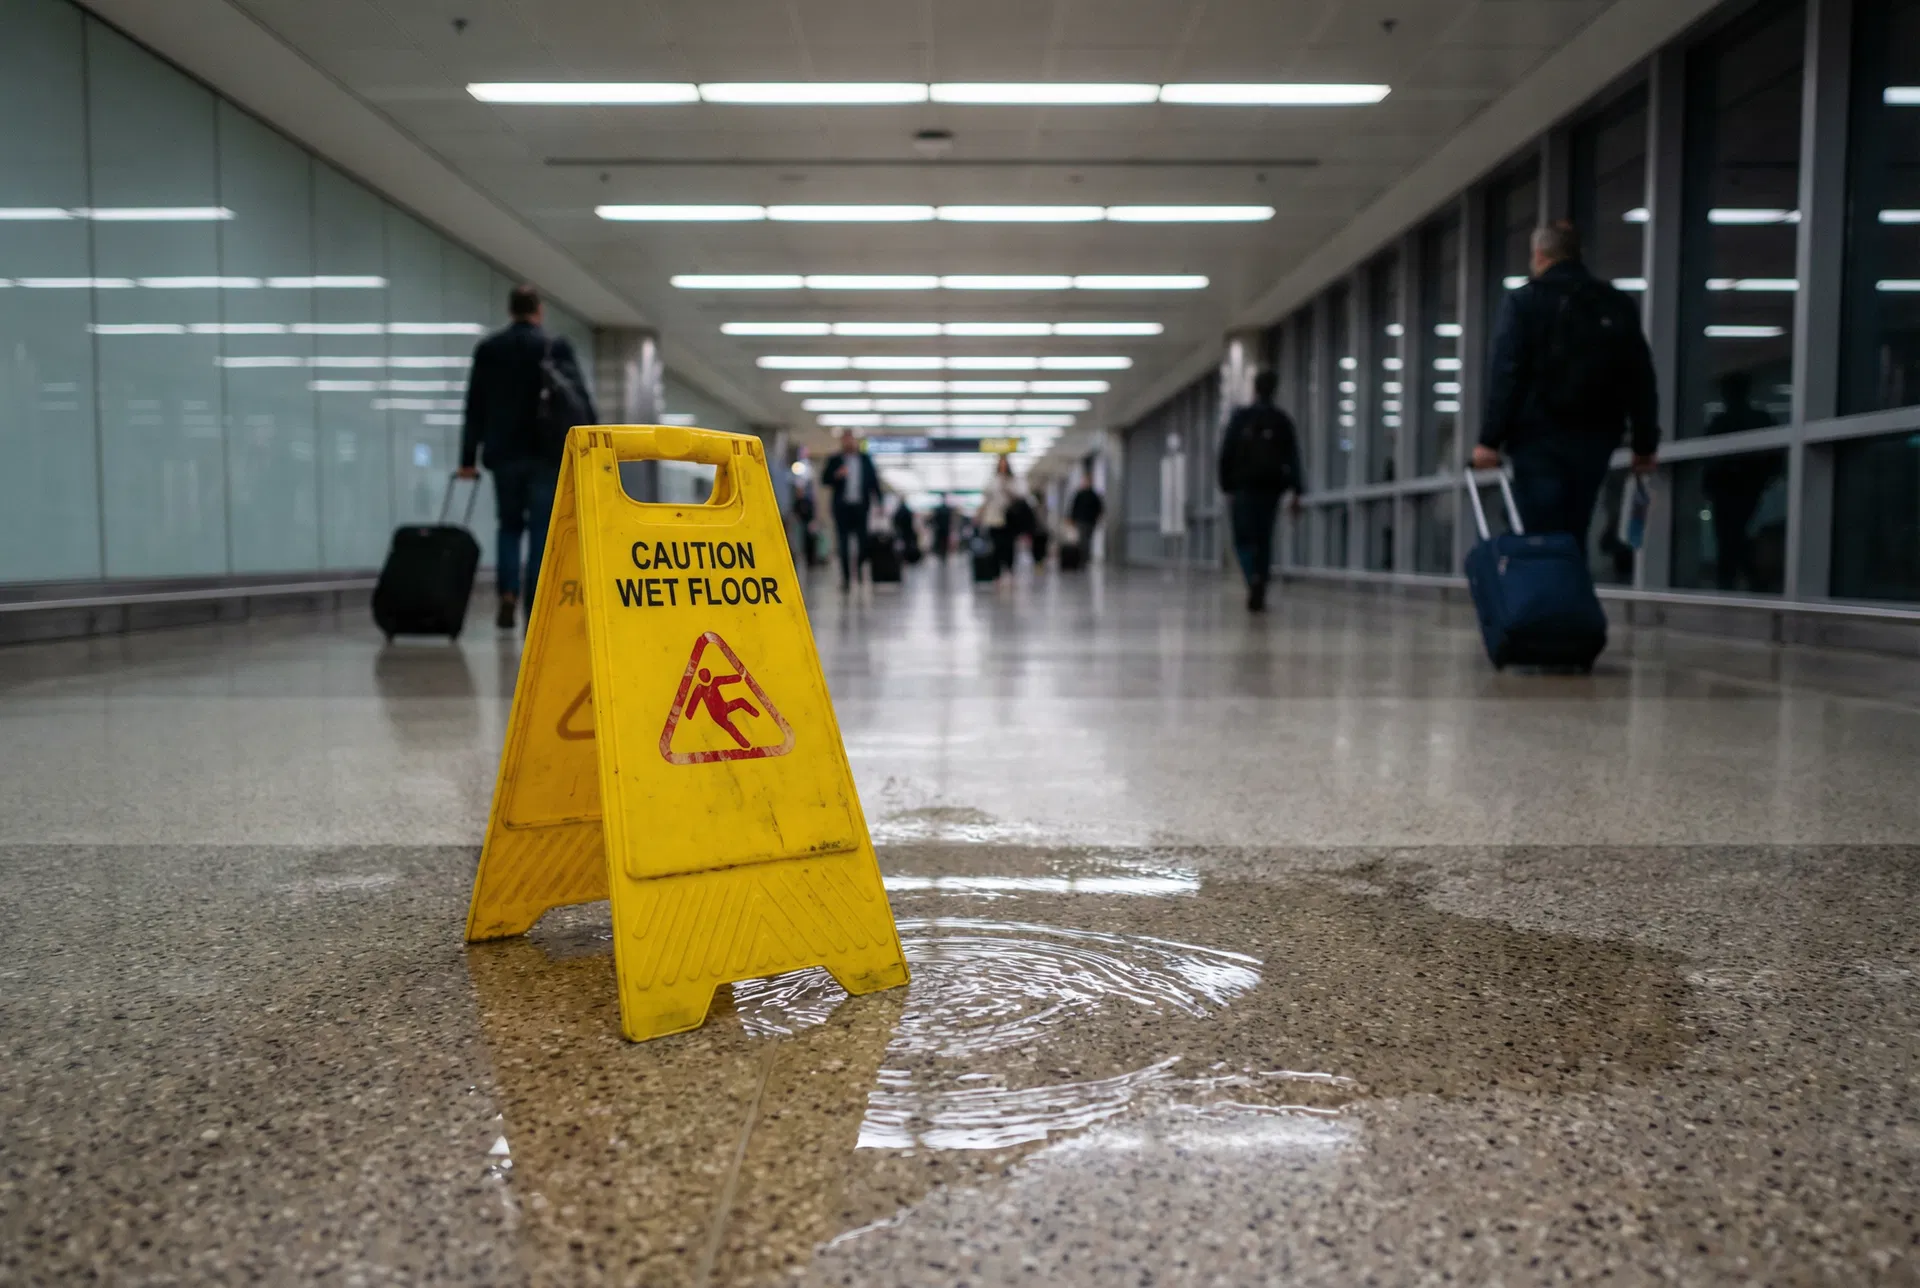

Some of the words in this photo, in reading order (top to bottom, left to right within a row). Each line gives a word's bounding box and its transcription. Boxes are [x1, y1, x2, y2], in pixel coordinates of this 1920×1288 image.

[631, 541, 756, 570] CAUTION
[616, 578, 679, 607] WET
[688, 577, 782, 606] FLOOR
